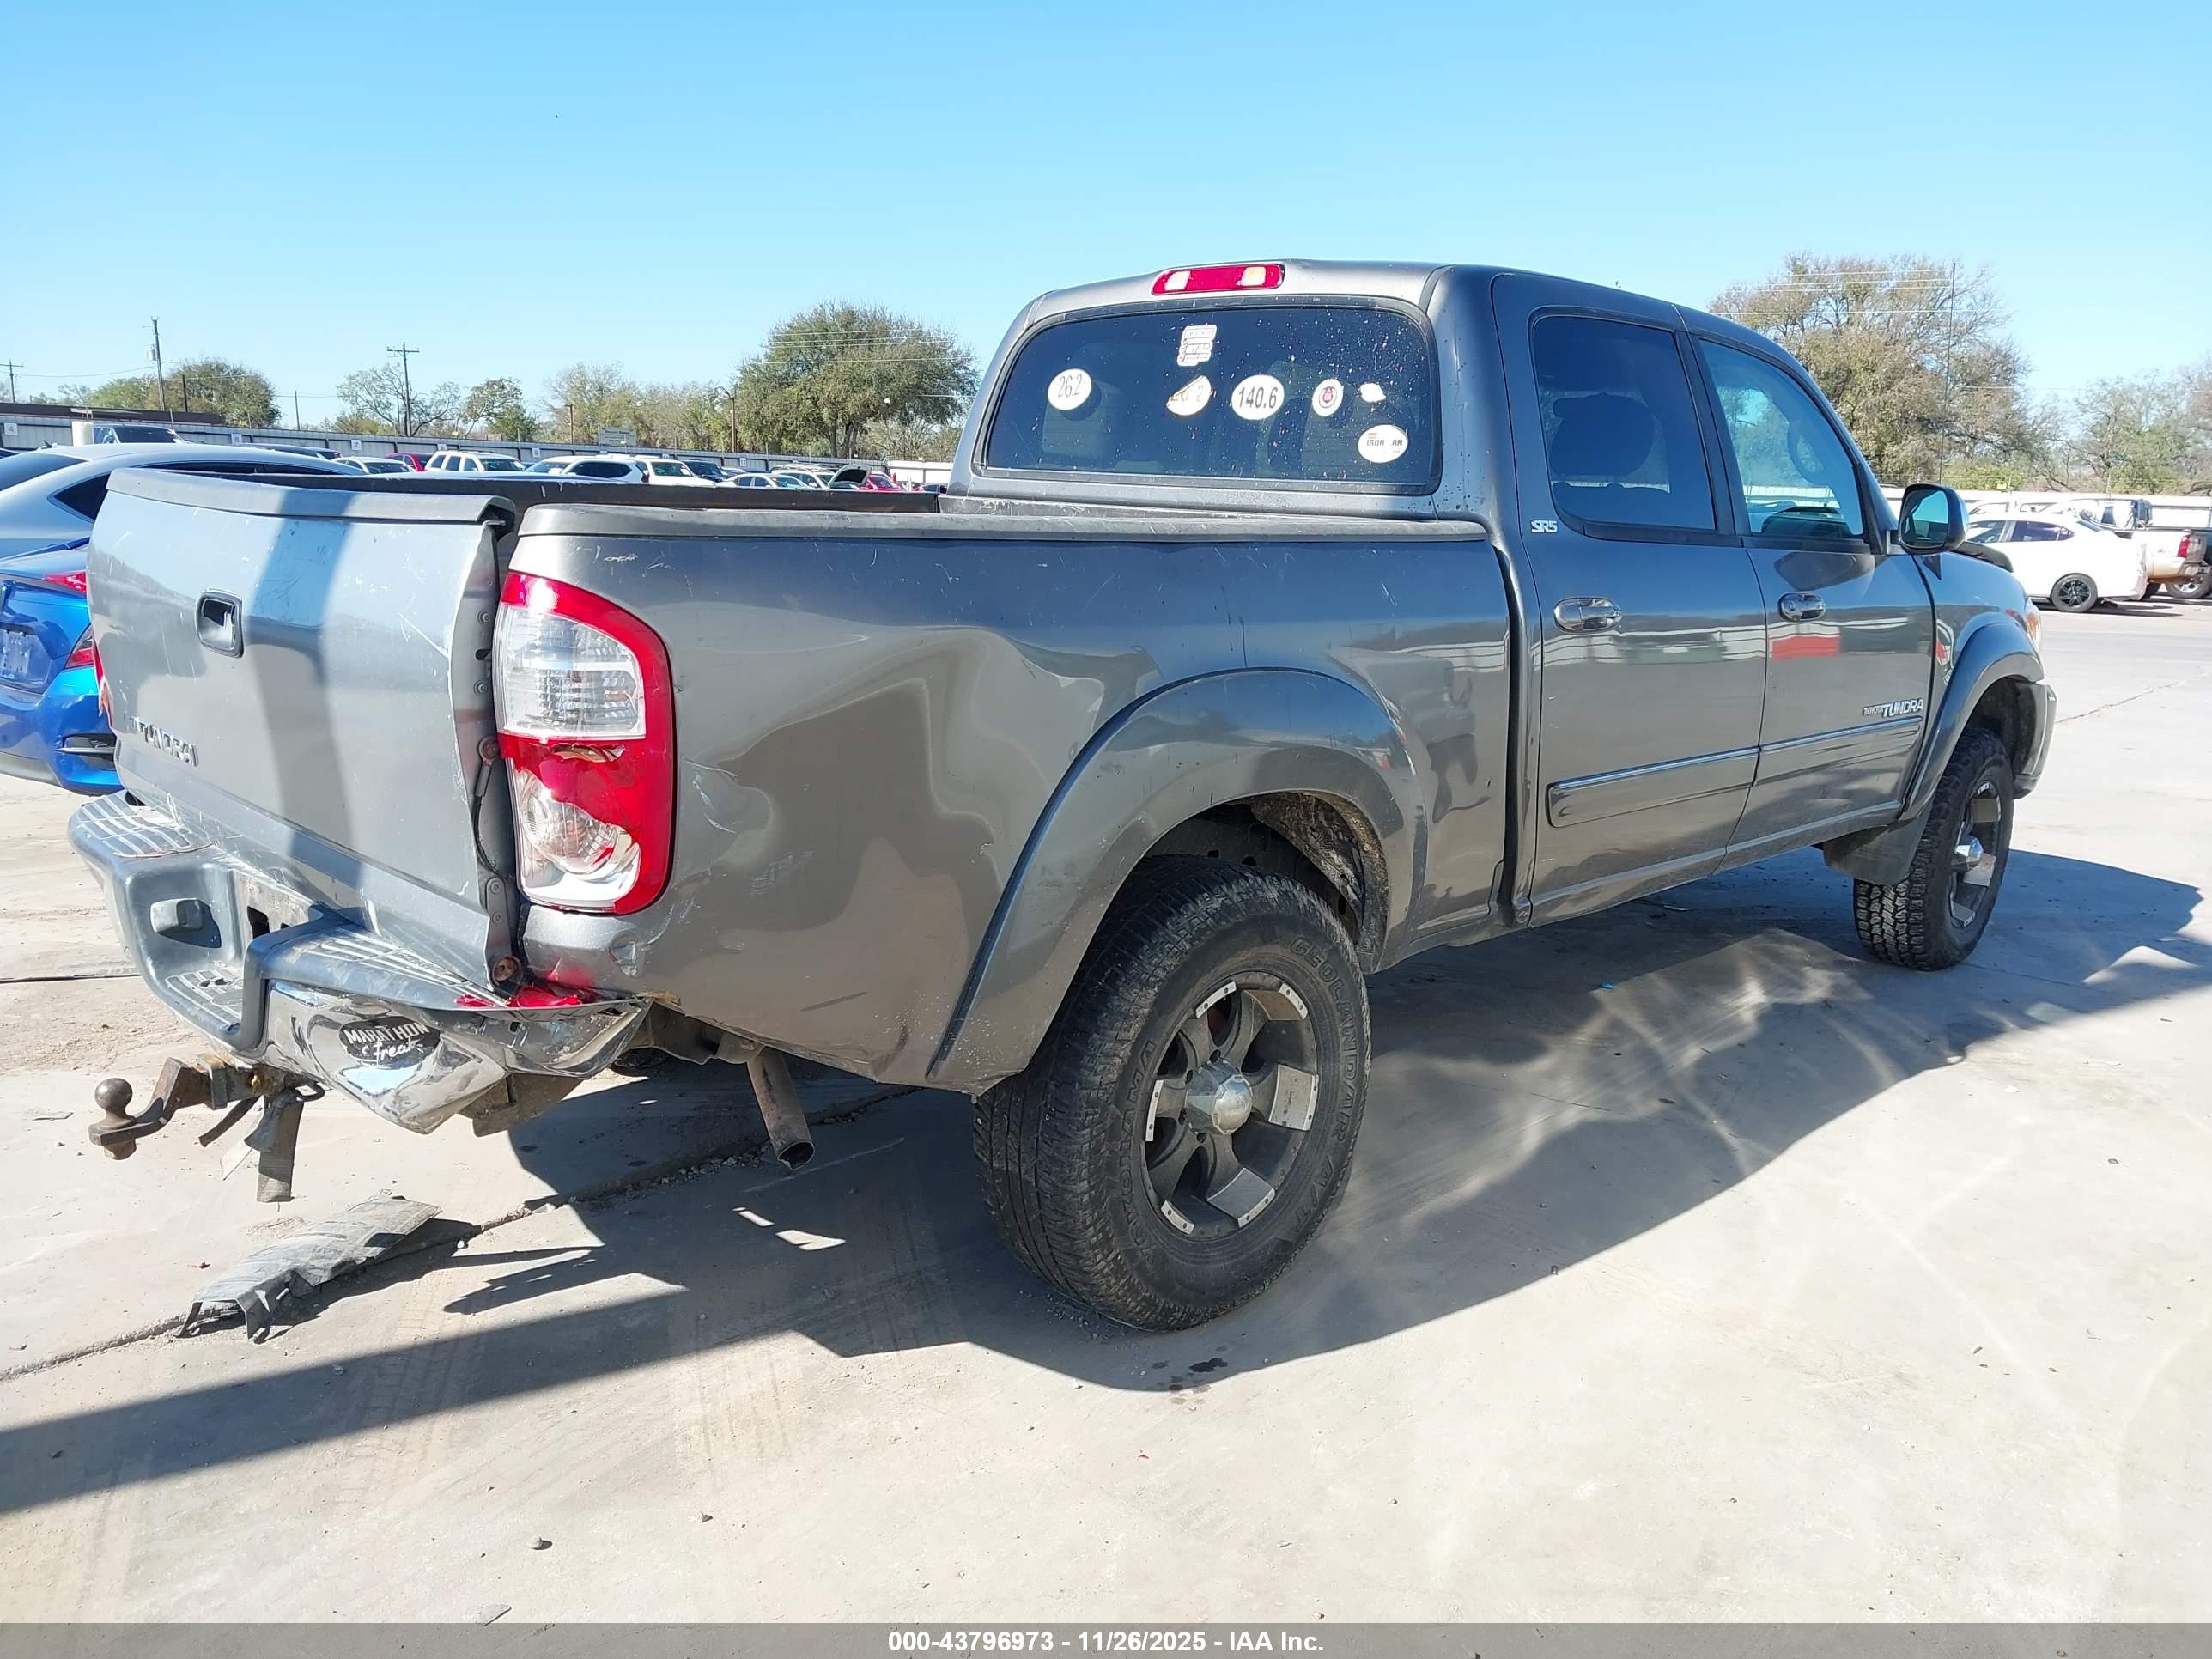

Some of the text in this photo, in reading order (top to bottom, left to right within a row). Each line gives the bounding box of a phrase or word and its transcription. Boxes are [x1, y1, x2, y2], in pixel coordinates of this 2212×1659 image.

[1058, 374, 1083, 398] 26.2
[1238, 386, 1279, 409] 140.6
[1531, 520, 1558, 533] SR5
[1882, 698, 1923, 717] TUNDRA
[343, 1022, 430, 1045] MARATHON
